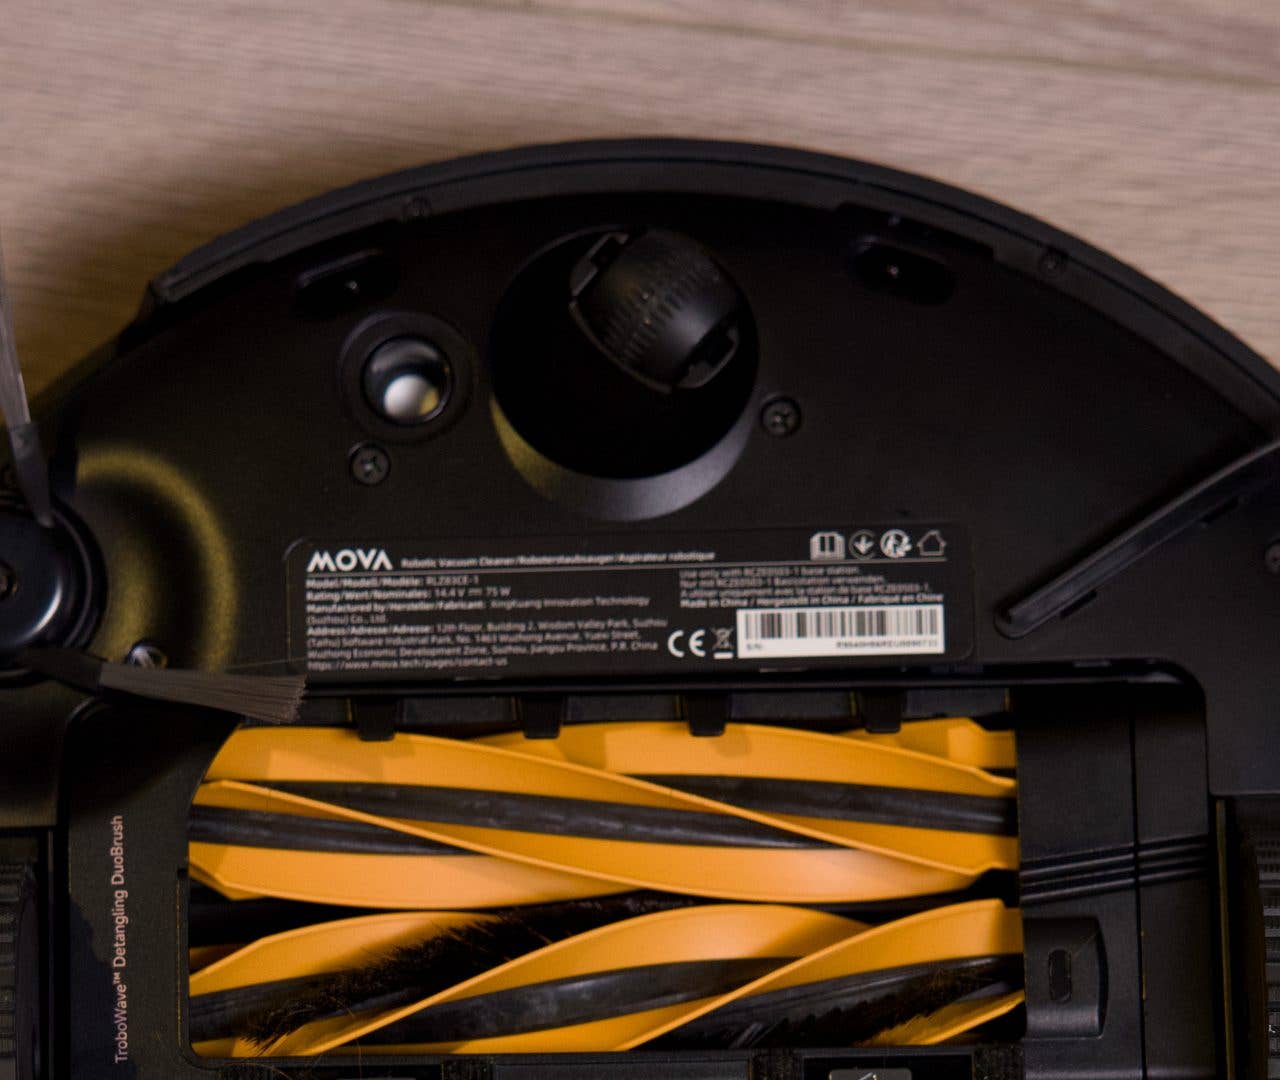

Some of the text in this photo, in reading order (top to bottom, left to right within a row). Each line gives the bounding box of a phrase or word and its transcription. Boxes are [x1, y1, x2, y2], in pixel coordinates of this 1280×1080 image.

[306, 547, 393, 572] MOVA
[438, 557, 477, 567] Vacuum
[543, 597, 593, 609] Innovation
[595, 596, 651, 608] Technology
[679, 598, 707, 608] Made
[708, 598, 719, 608] in
[720, 597, 748, 607] China
[821, 595, 849, 605] China
[487, 621, 525, 632] Building
[398, 645, 461, 658] Development
[630, 641, 658, 653] China
[110, 815, 124, 885] DuoBrush
[112, 890, 128, 968] Detangling
